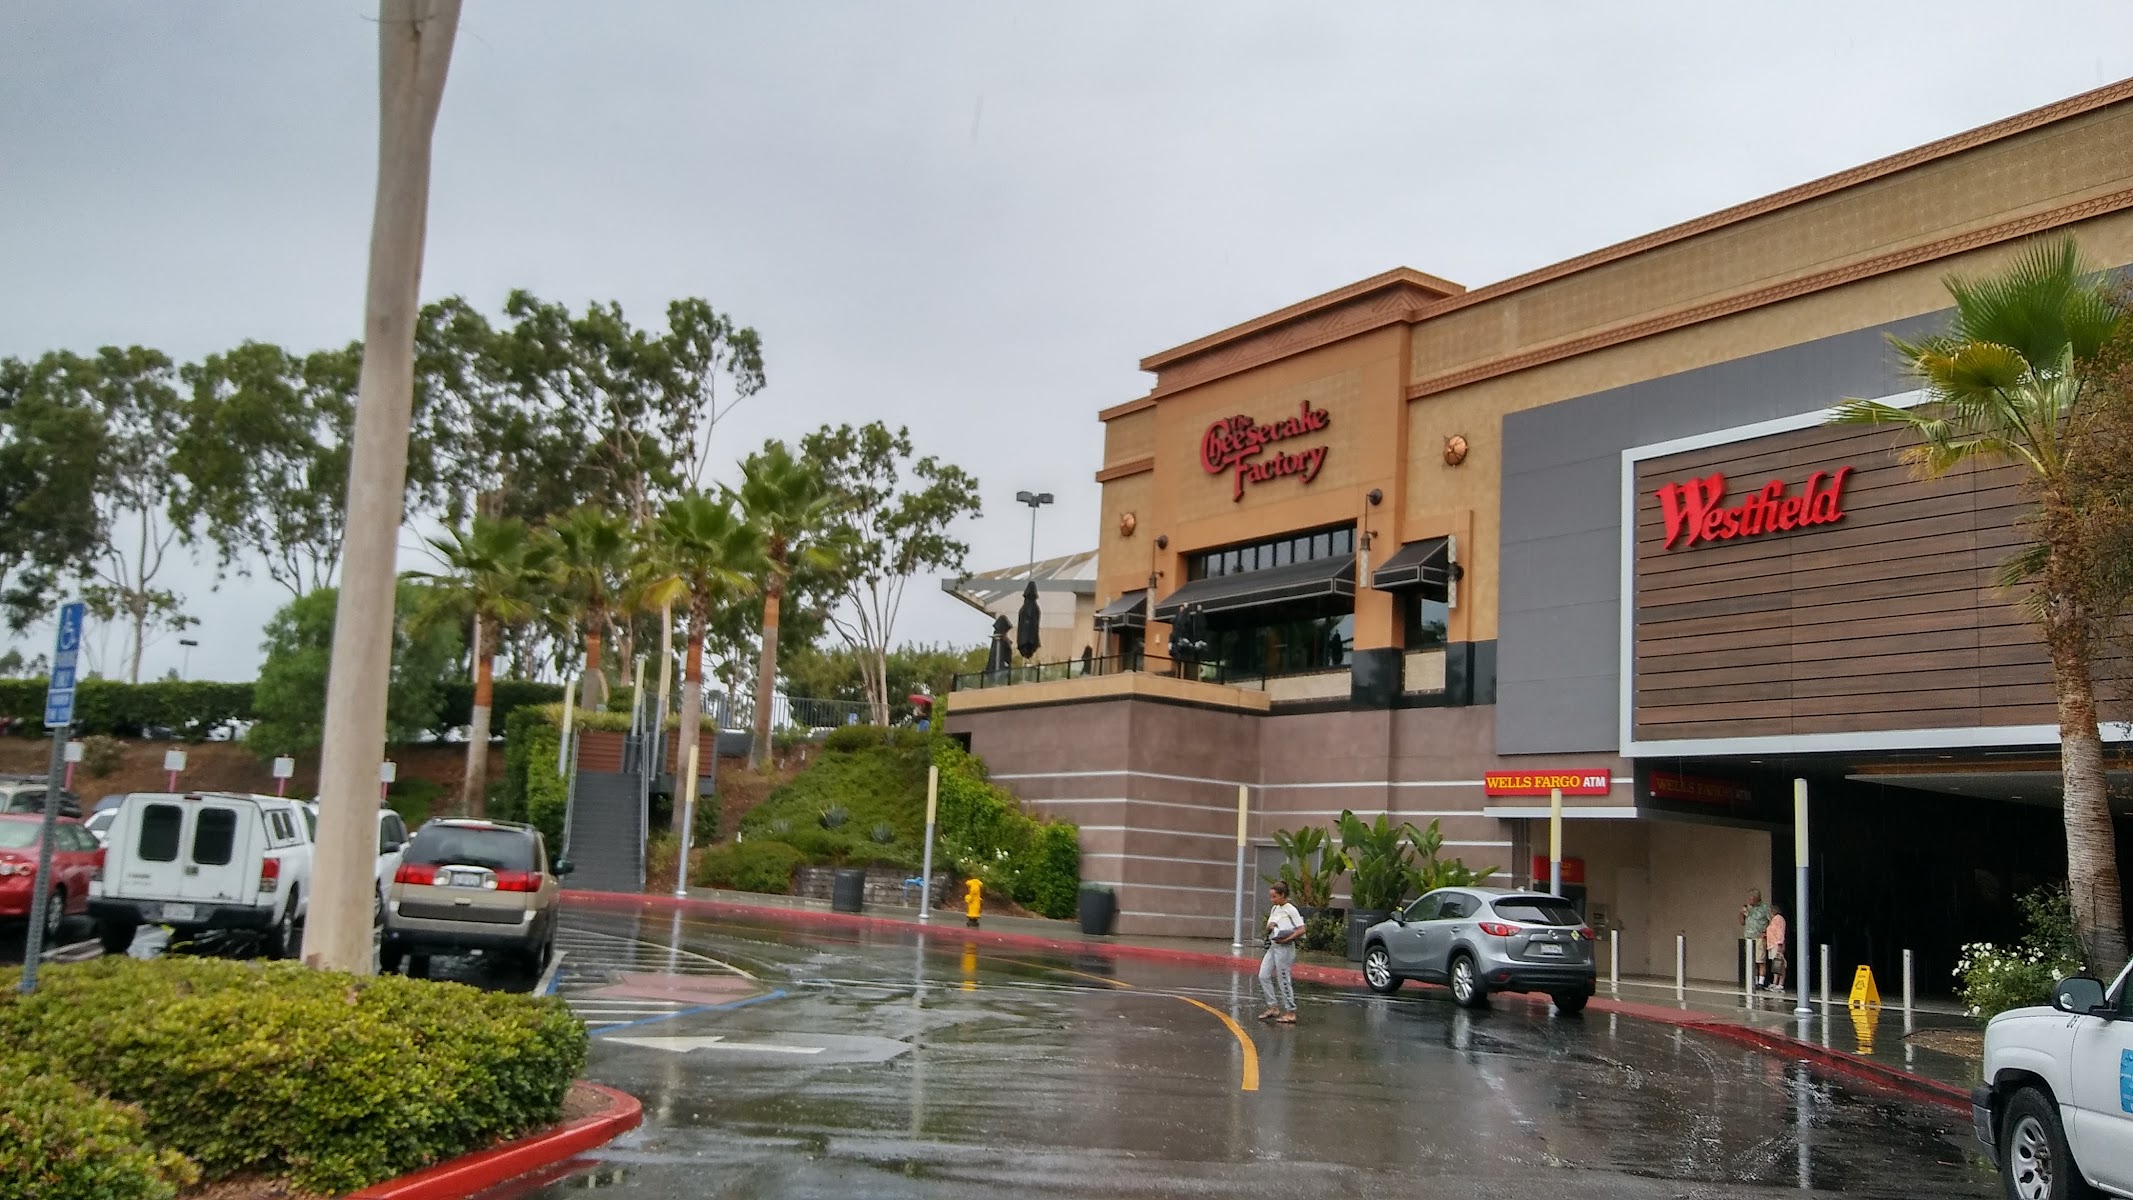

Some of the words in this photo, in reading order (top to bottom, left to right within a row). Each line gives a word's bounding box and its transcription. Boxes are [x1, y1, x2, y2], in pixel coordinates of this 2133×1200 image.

[1201, 400, 1330, 474] Cheesecake
[1228, 415, 1254, 434] The
[1223, 446, 1329, 503] Factory
[1655, 465, 1854, 550] Westfield
[1486, 776, 1532, 789] WELLS
[1534, 775, 1580, 788] FARGO
[1582, 776, 1606, 788] ATM
